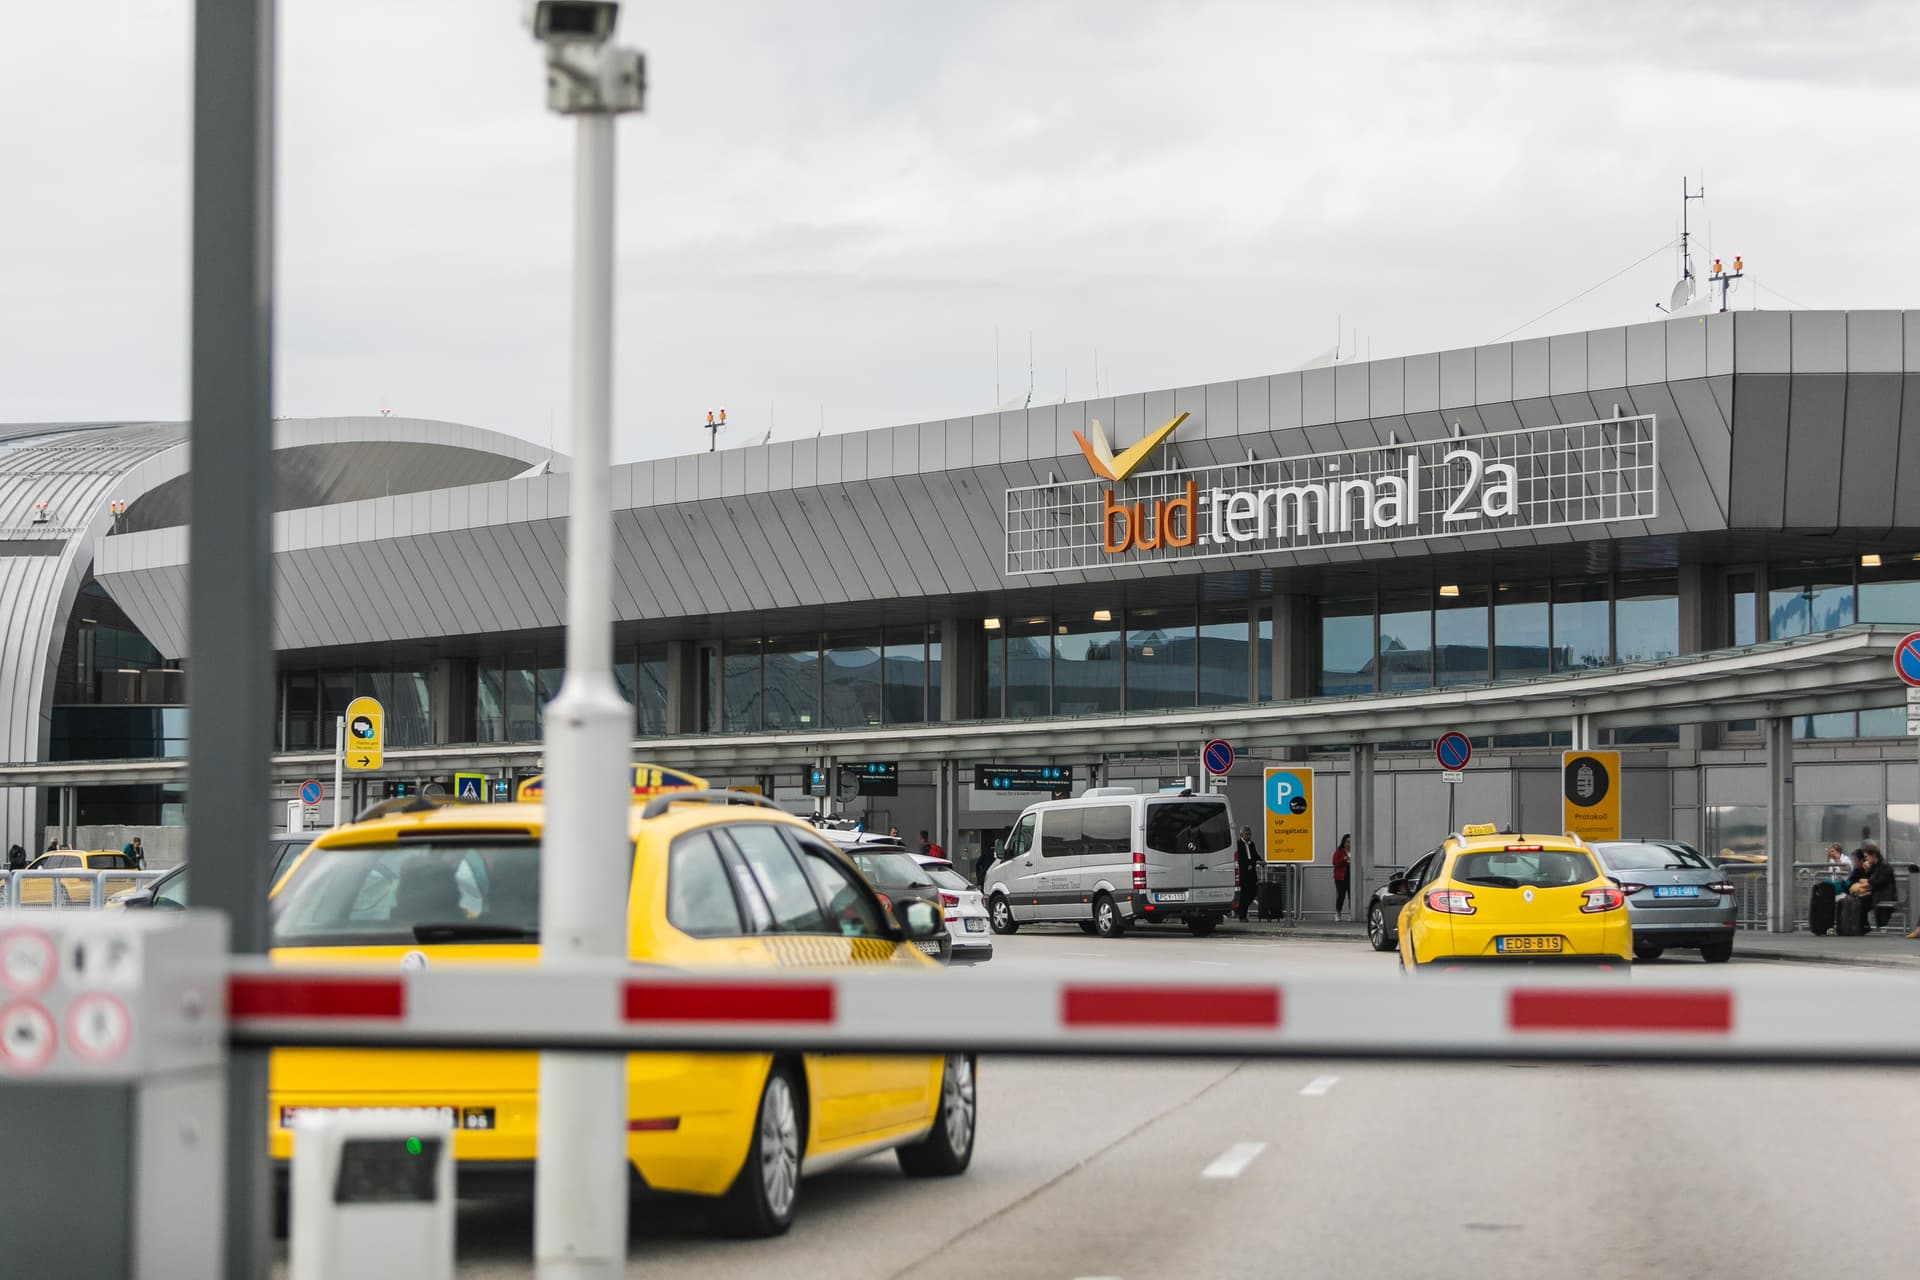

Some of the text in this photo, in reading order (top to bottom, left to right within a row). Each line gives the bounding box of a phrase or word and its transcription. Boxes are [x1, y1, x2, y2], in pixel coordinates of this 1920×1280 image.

[1442, 449, 1519, 523] 2a
[1277, 782, 1292, 805] P
[1505, 937, 1560, 950] EDB-819
